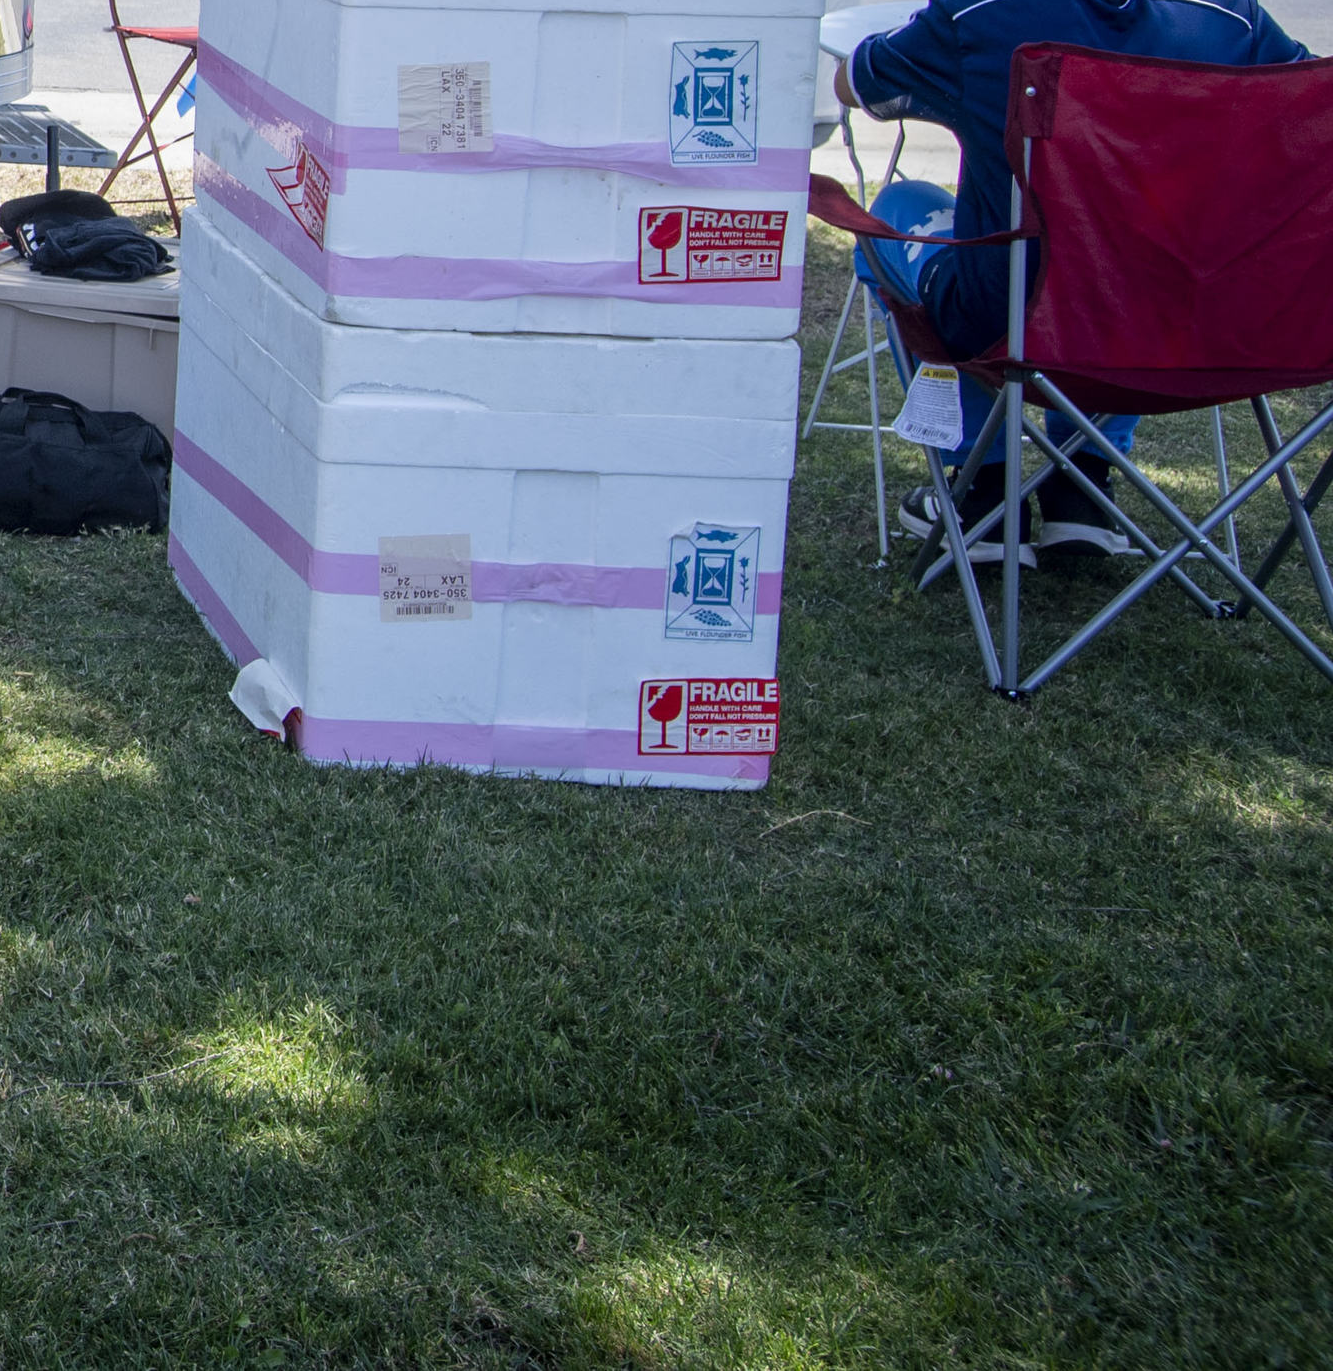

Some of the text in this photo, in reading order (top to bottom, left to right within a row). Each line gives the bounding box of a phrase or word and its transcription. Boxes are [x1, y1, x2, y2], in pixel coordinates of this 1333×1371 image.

[441, 70, 452, 136] LAX 22
[454, 68, 467, 149] 350-3404 7381
[689, 210, 785, 230] FRAGILE
[689, 230, 720, 238] HANDLE
[744, 239, 781, 247] PRESSURE
[380, 566, 397, 574] ICN
[397, 575, 464, 586] LAX 24
[383, 588, 467, 600] 350-3404 7425
[689, 682, 778, 702] FRAGILE
[689, 704, 762, 712] HANDLE WITH CARE
